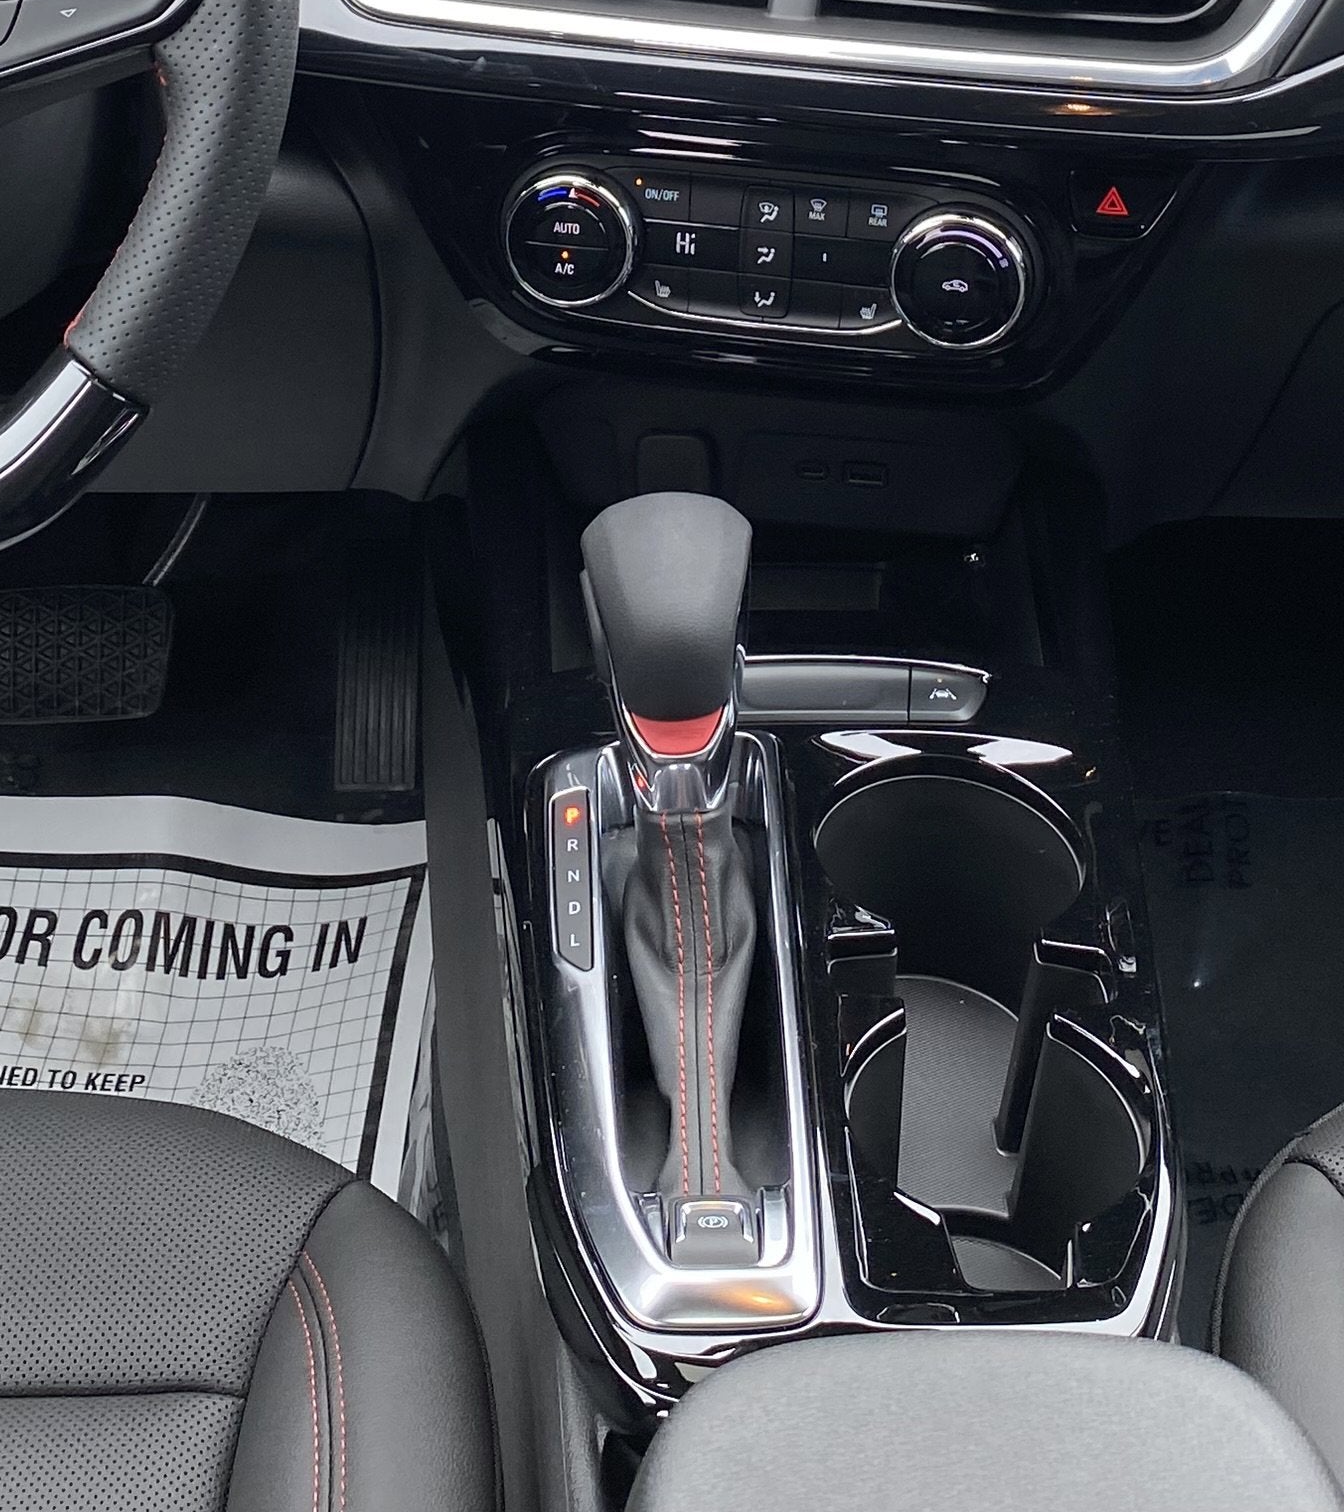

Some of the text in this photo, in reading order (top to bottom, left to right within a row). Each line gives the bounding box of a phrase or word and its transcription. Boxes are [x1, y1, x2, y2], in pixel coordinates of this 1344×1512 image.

[644, 187, 680, 202] ON/OFF
[808, 211, 826, 222] MAX
[868, 216, 888, 228] REAR
[553, 221, 581, 236] AUTO
[675, 231, 697, 256] Hi
[554, 262, 575, 276] A/C
[565, 806, 581, 825] P
[566, 838, 580, 853] R
[567, 869, 581, 883] N
[568, 901, 582, 915] D
[72, 908, 295, 980] COMING
[311, 915, 368, 972] IN
[570, 934, 581, 947] L
[47, 1069, 78, 1089] TO
[84, 1072, 146, 1093] KEEP
